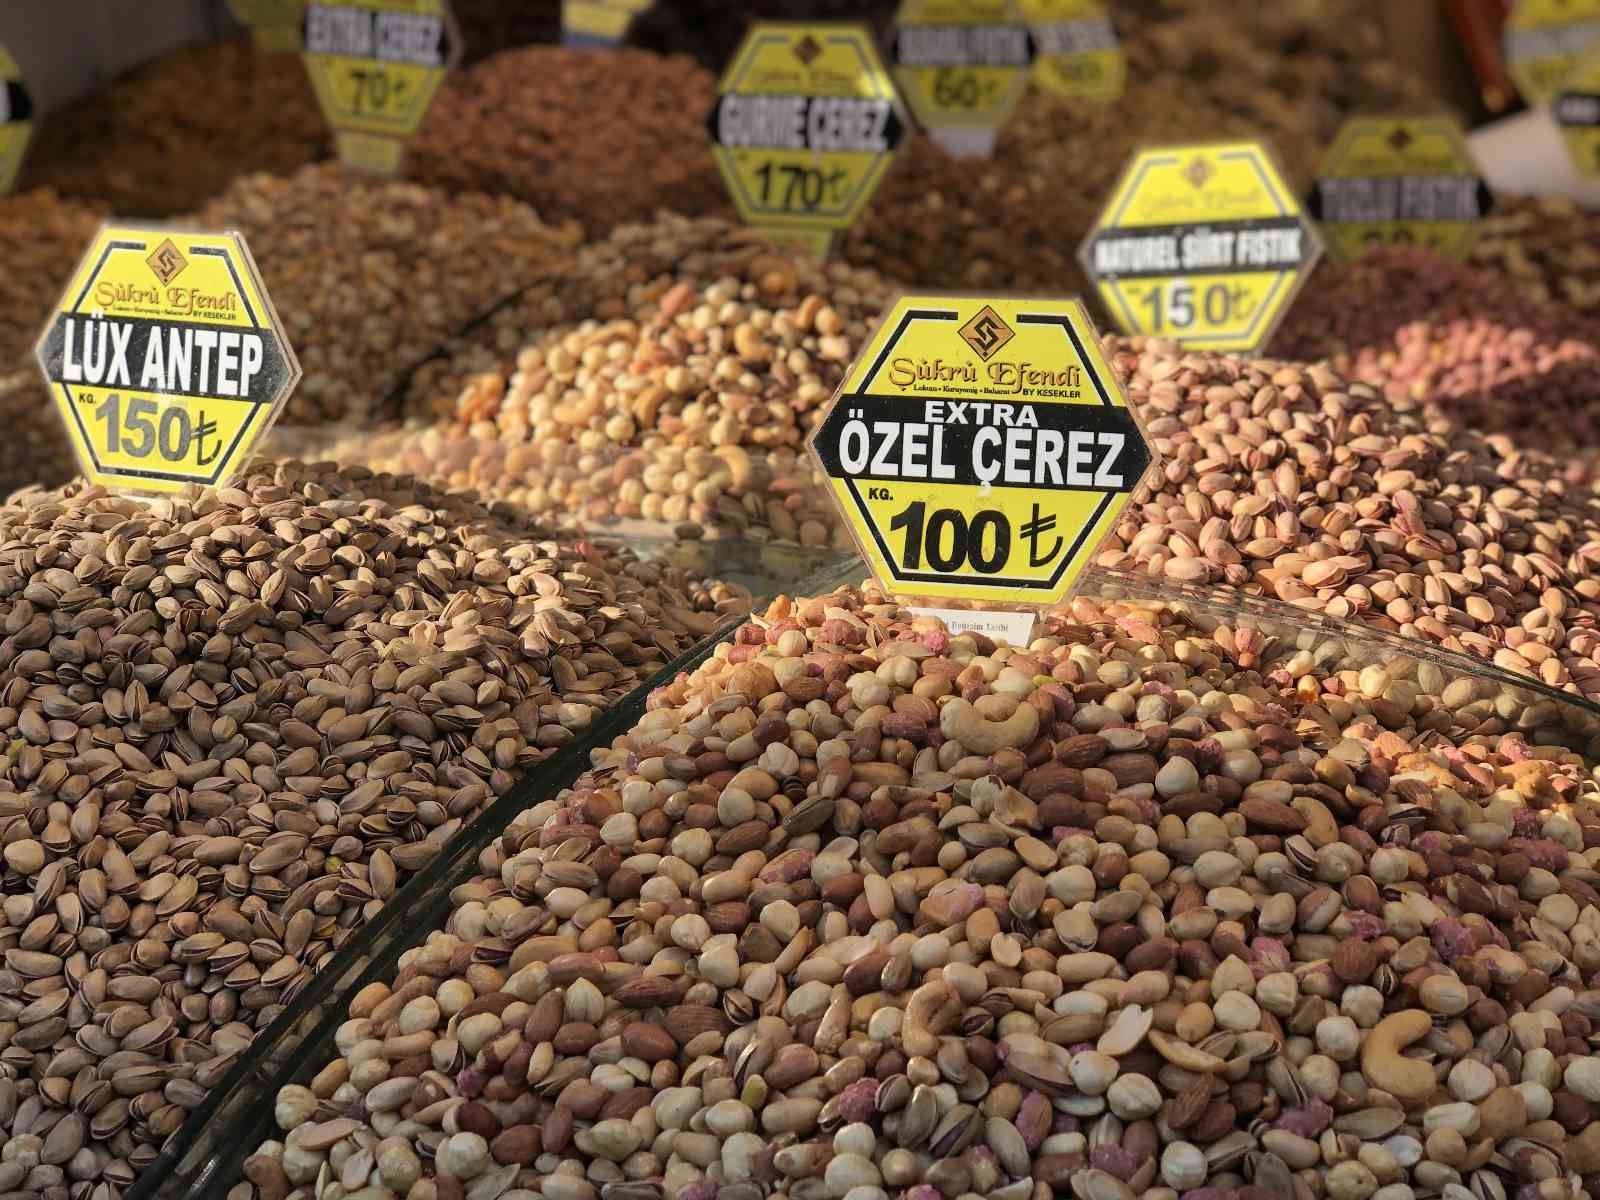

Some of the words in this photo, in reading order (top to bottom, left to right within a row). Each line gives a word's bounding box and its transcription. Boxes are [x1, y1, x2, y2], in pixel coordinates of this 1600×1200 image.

[167, 287, 237, 315] Efendi
[63, 309, 134, 386] LÜX
[140, 325, 263, 397] ANTEP
[988, 361, 1081, 394] Efendi
[1022, 388, 1034, 396] BY
[924, 401, 1038, 428] EXTRA
[838, 408, 956, 480] ÖZEL
[971, 426, 1125, 497] ÇEREZ
[868, 487, 894, 501] KG.
